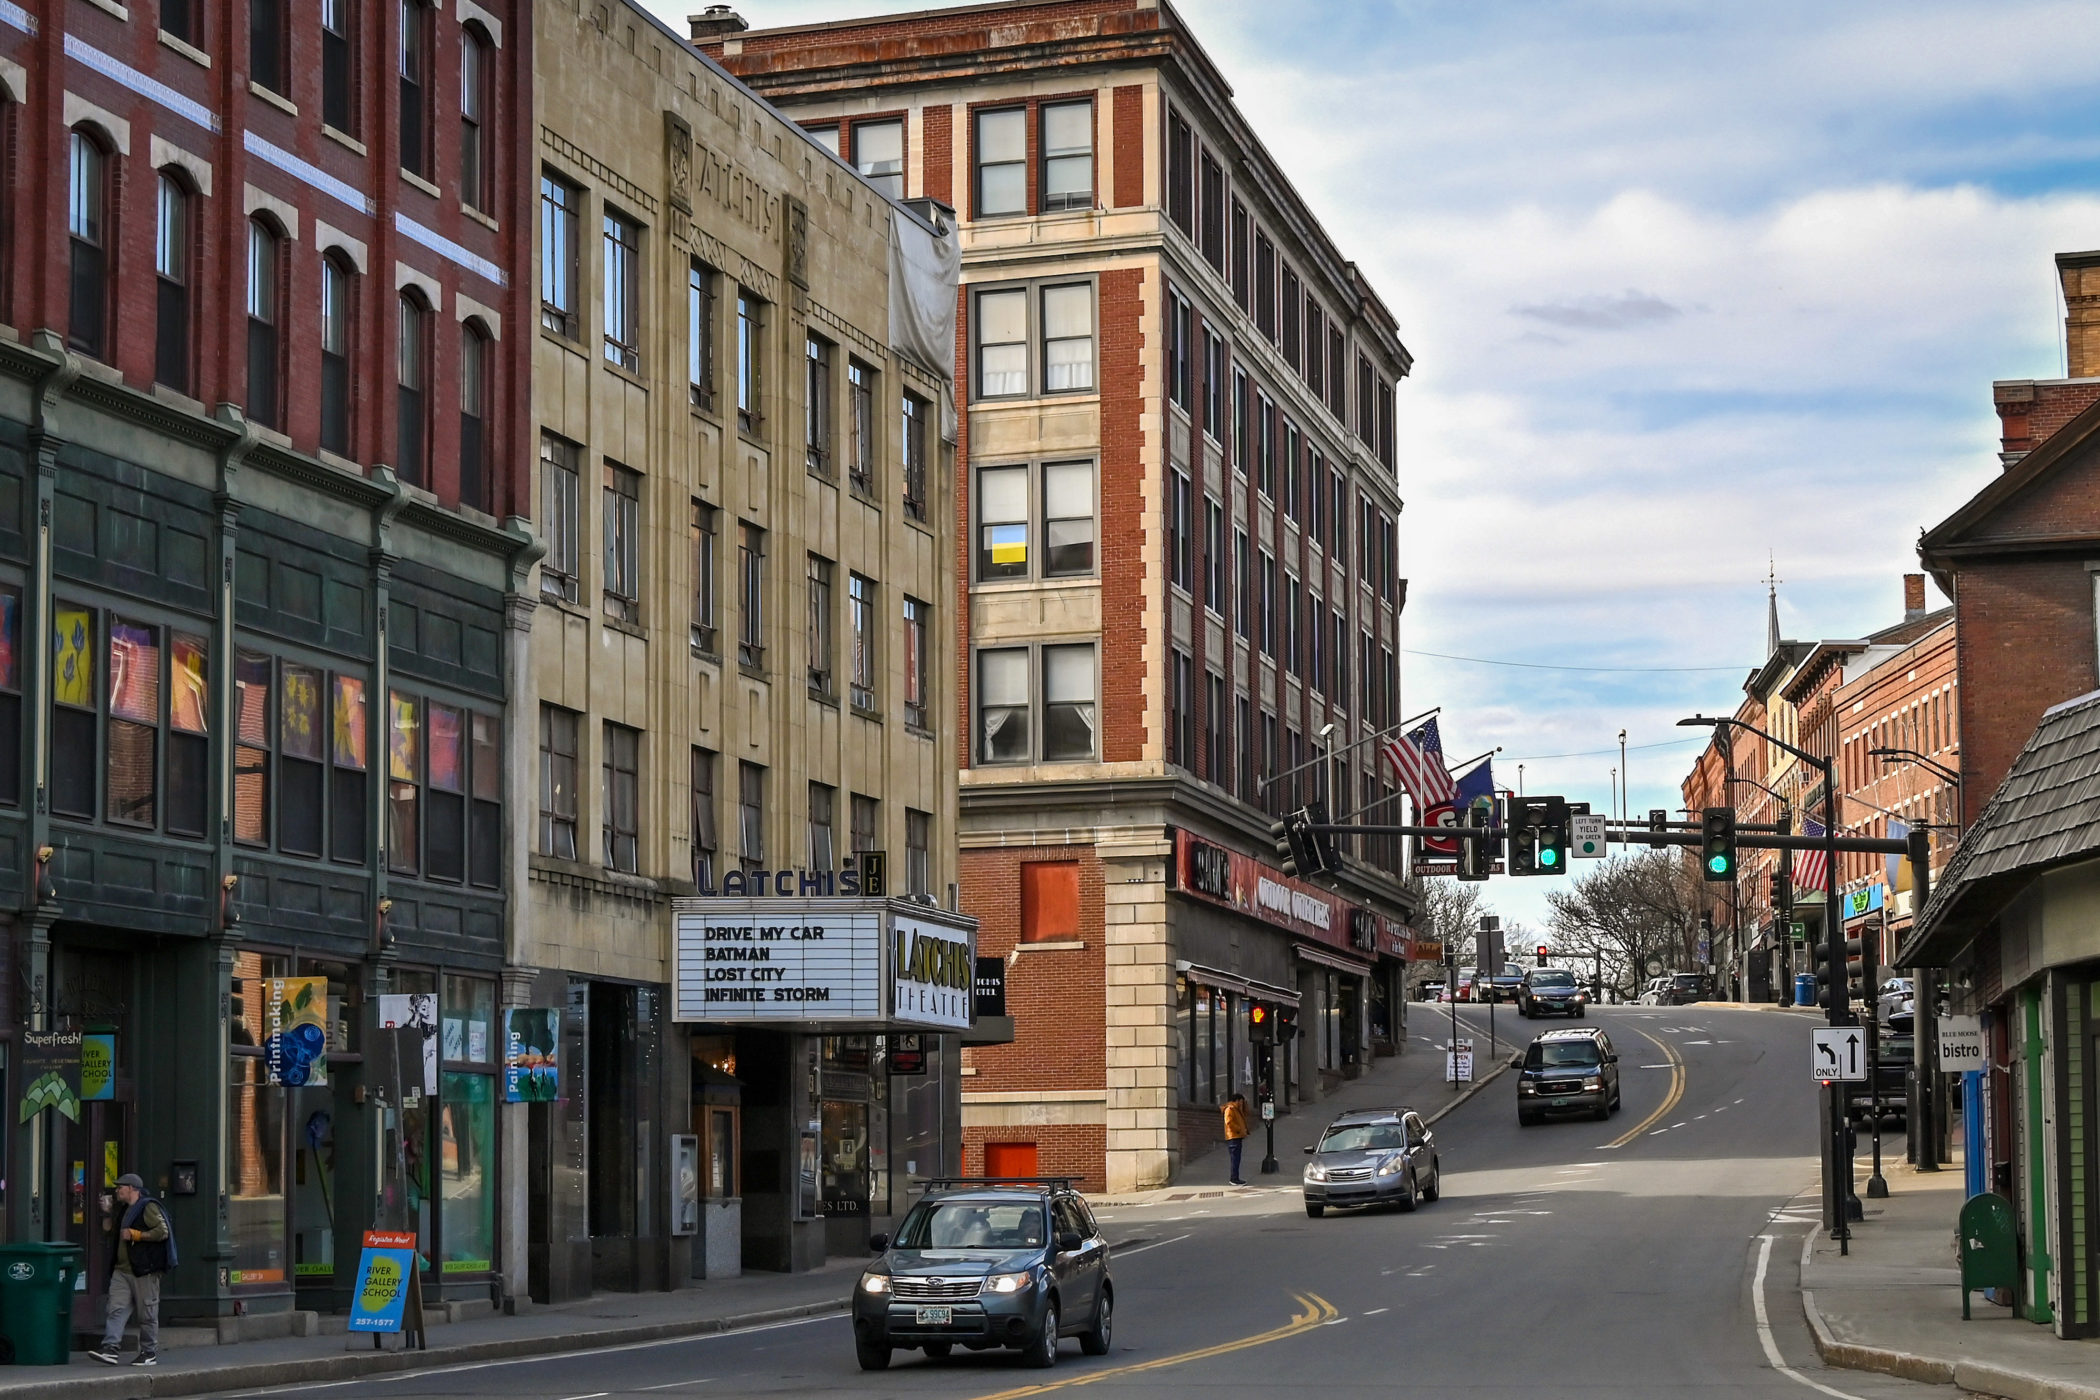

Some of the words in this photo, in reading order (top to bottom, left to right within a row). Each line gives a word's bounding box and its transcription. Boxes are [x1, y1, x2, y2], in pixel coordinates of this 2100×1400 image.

[1415, 864, 1451, 874] OUTDOOR
[697, 859, 862, 897] LATCHIS
[705, 927, 752, 940] DRIVE
[760, 927, 785, 940] MY
[790, 926, 824, 940] CAR
[706, 947, 770, 960] BATMAN
[897, 927, 971, 991] LATCHIS
[706, 967, 746, 981] LOST
[751, 967, 786, 981] CITY
[705, 988, 765, 1001] INFINITE
[774, 987, 829, 1000] STORM
[897, 985, 968, 1019] THEATRE
[269, 979, 284, 1082] Printmaking
[24, 1031, 82, 1047] Superfresh!
[83, 1050, 100, 1058] IVER
[1943, 1043, 1979, 1057] bistro
[509, 1031, 520, 1092] Painting
[1816, 1068, 1837, 1076] ONLY
[837, 1200, 859, 1211] LTD.
[368, 1234, 393, 1246] Register
[367, 1266, 391, 1275] RIVER
[365, 1277, 403, 1286] GALLERY
[363, 1288, 401, 1298] SCHOOL
[355, 1318, 394, 1326] 257-1577
